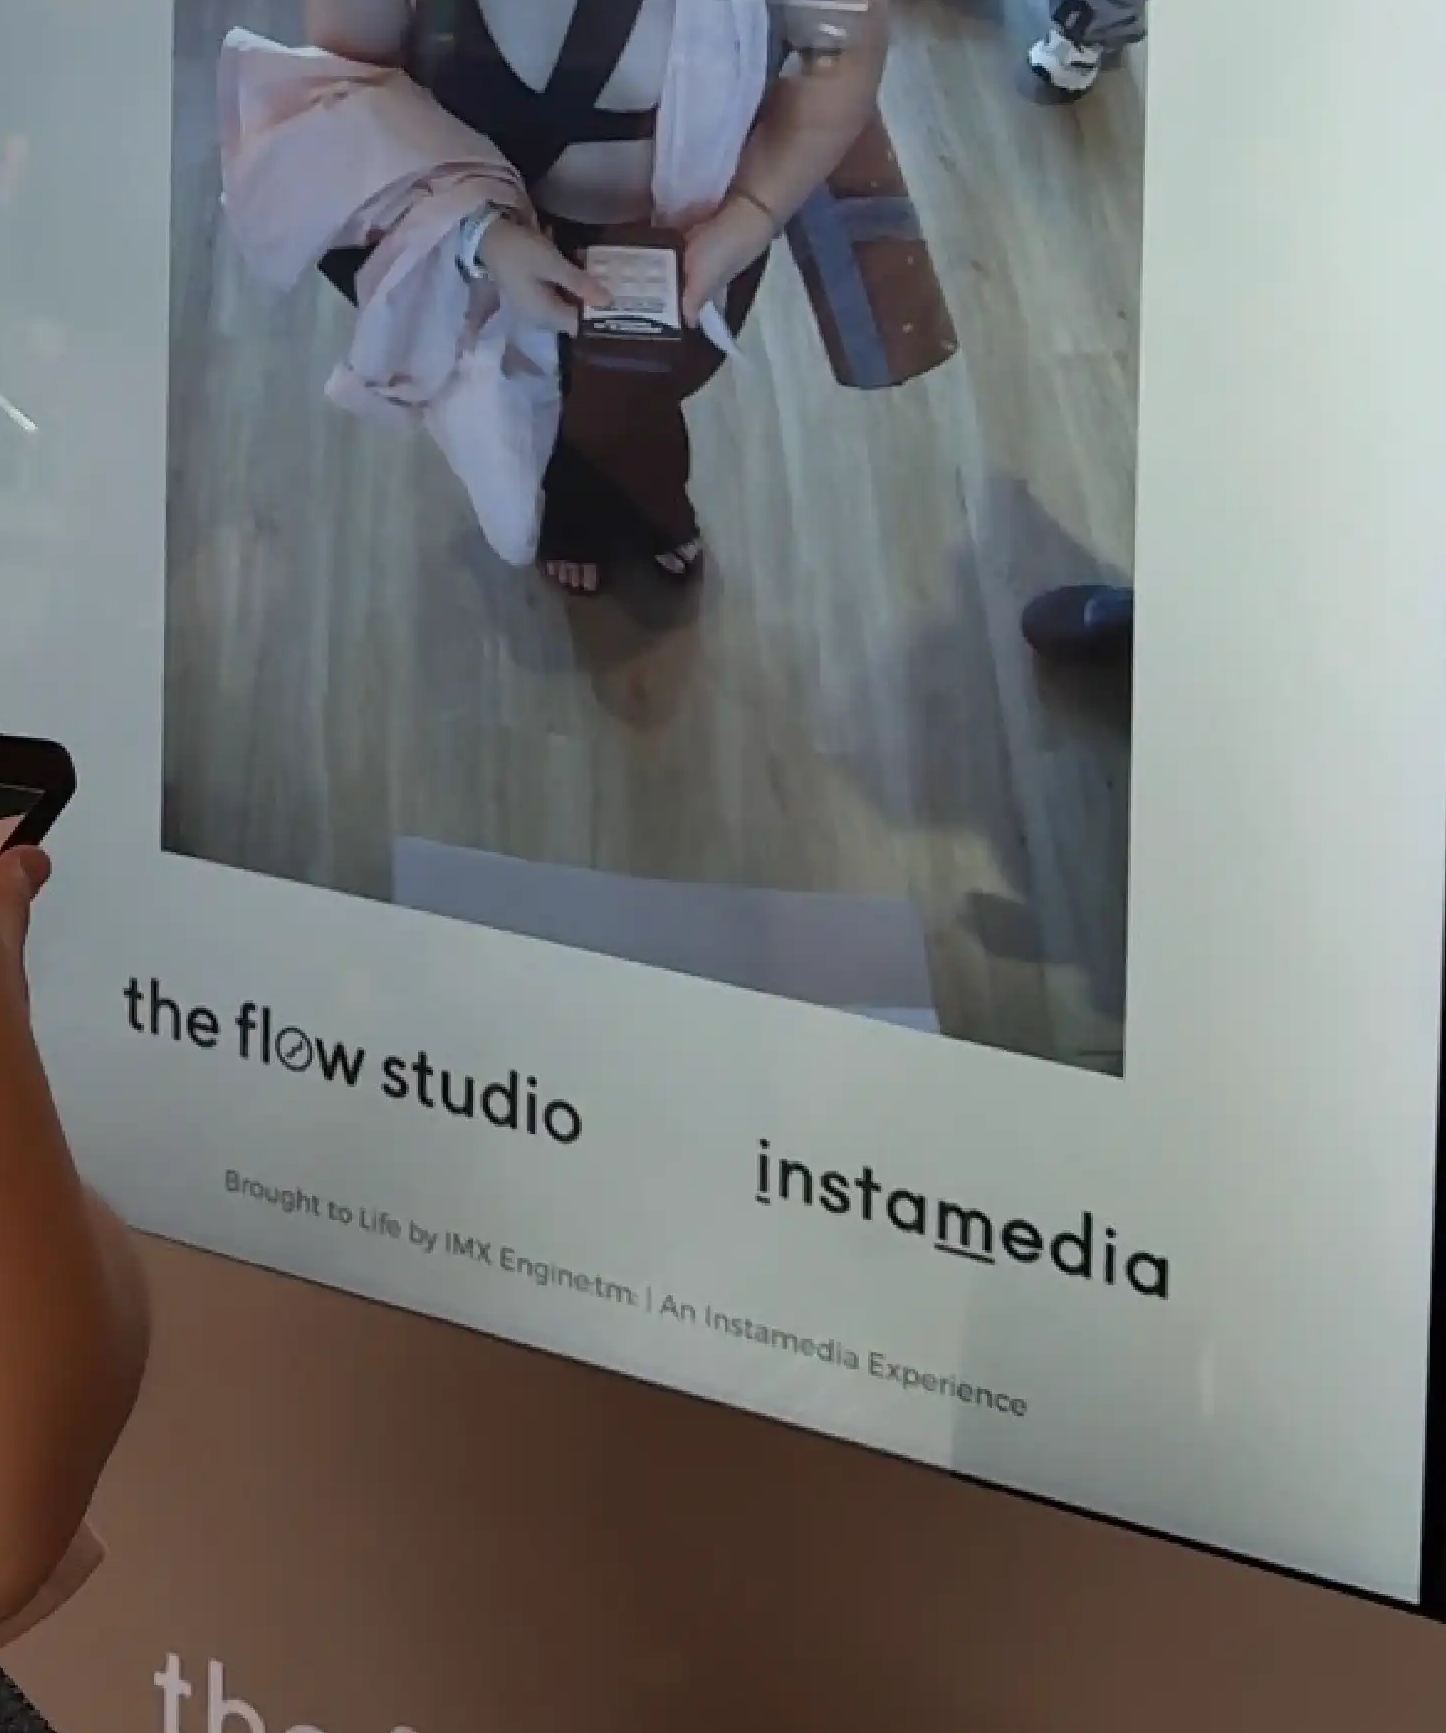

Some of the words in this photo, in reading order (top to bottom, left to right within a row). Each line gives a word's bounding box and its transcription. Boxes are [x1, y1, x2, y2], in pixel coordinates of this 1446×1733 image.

[123, 977, 221, 1048] the
[235, 1000, 365, 1088] flow
[381, 1051, 583, 1144] studio
[225, 1169, 320, 1217] Brought
[328, 1199, 353, 1225] to
[359, 1207, 402, 1239] Life
[409, 1220, 438, 1254] by
[445, 1232, 492, 1266] IMX
[659, 1294, 696, 1323] An
[704, 1304, 860, 1370] Instamedia
[867, 1351, 1028, 1417] Experience
[756, 1139, 1170, 1299] instamedia
[154, 1652, 329, 1733] th
